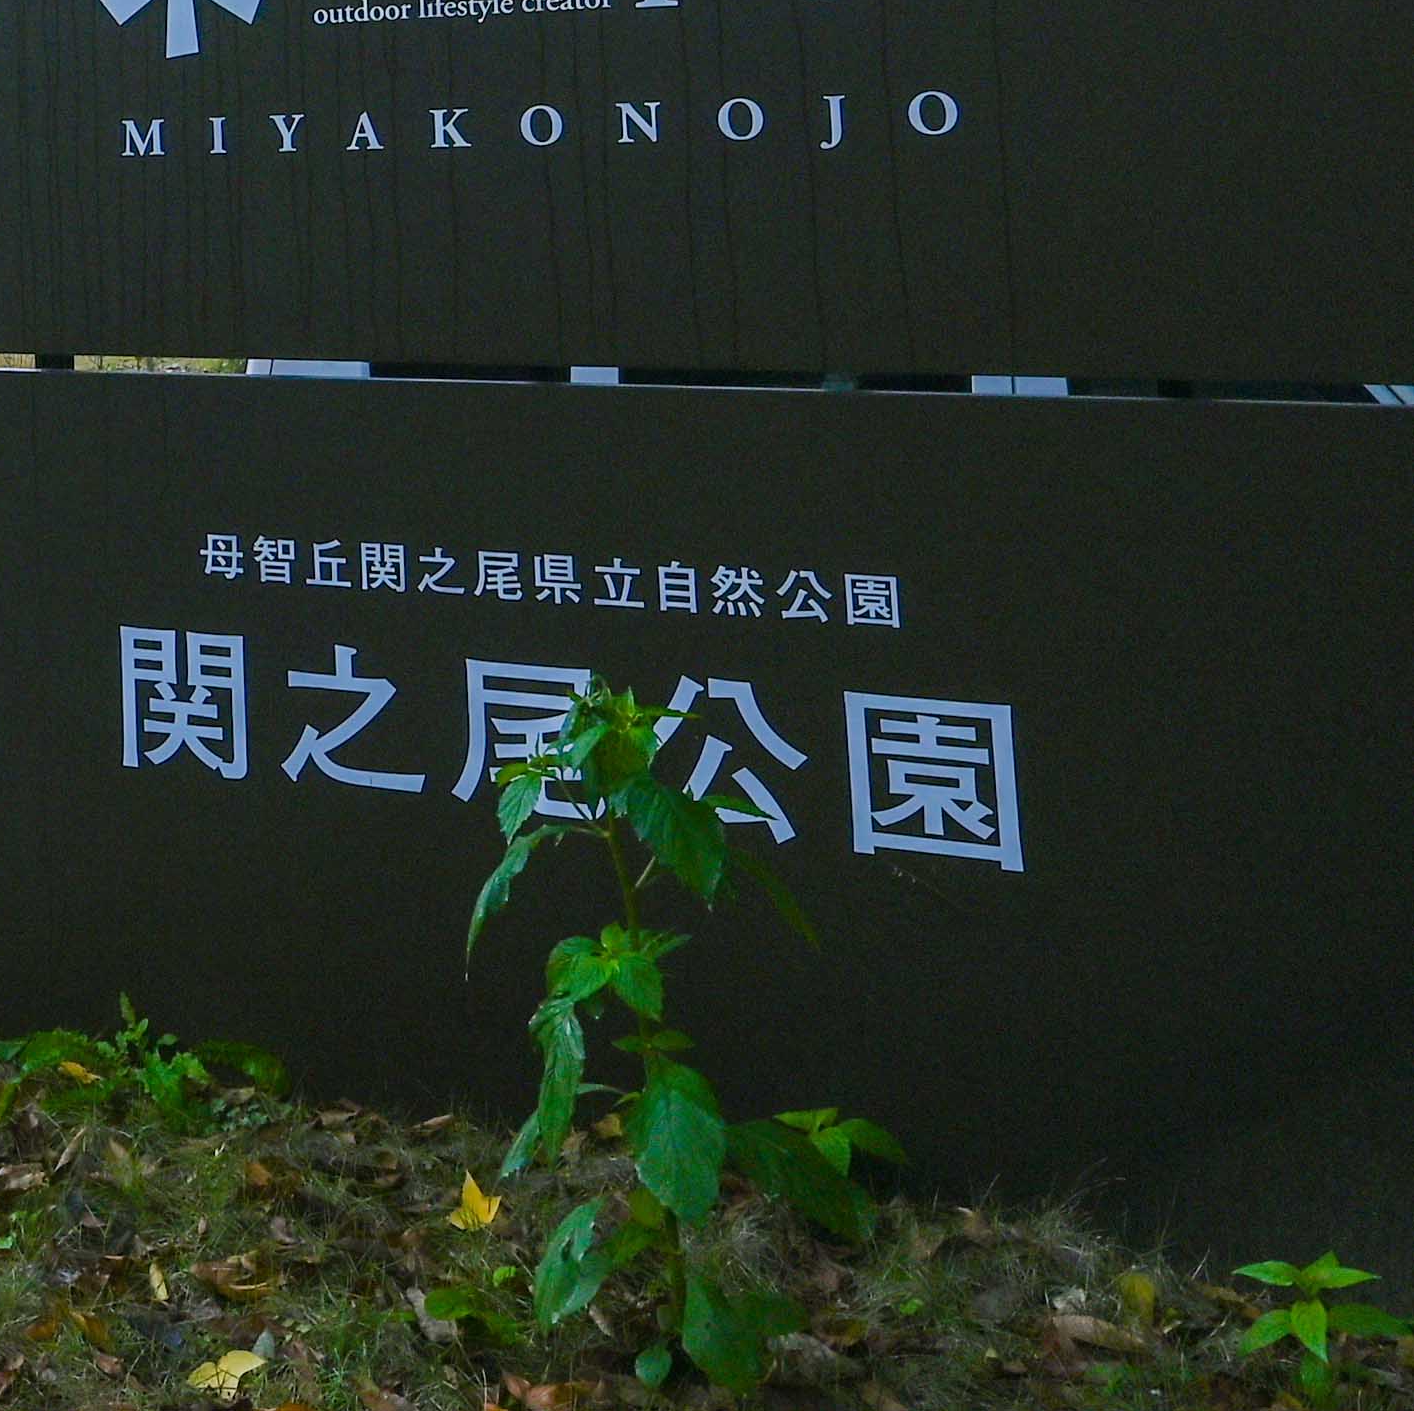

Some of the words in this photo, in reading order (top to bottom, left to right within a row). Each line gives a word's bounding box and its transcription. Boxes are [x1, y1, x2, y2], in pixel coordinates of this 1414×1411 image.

[121, 90, 959, 157] MIYAKONOJO
[198, 532, 902, 630] 母智丘関之尾県立自然公園
[118, 624, 1024, 872] 関之尾公園
